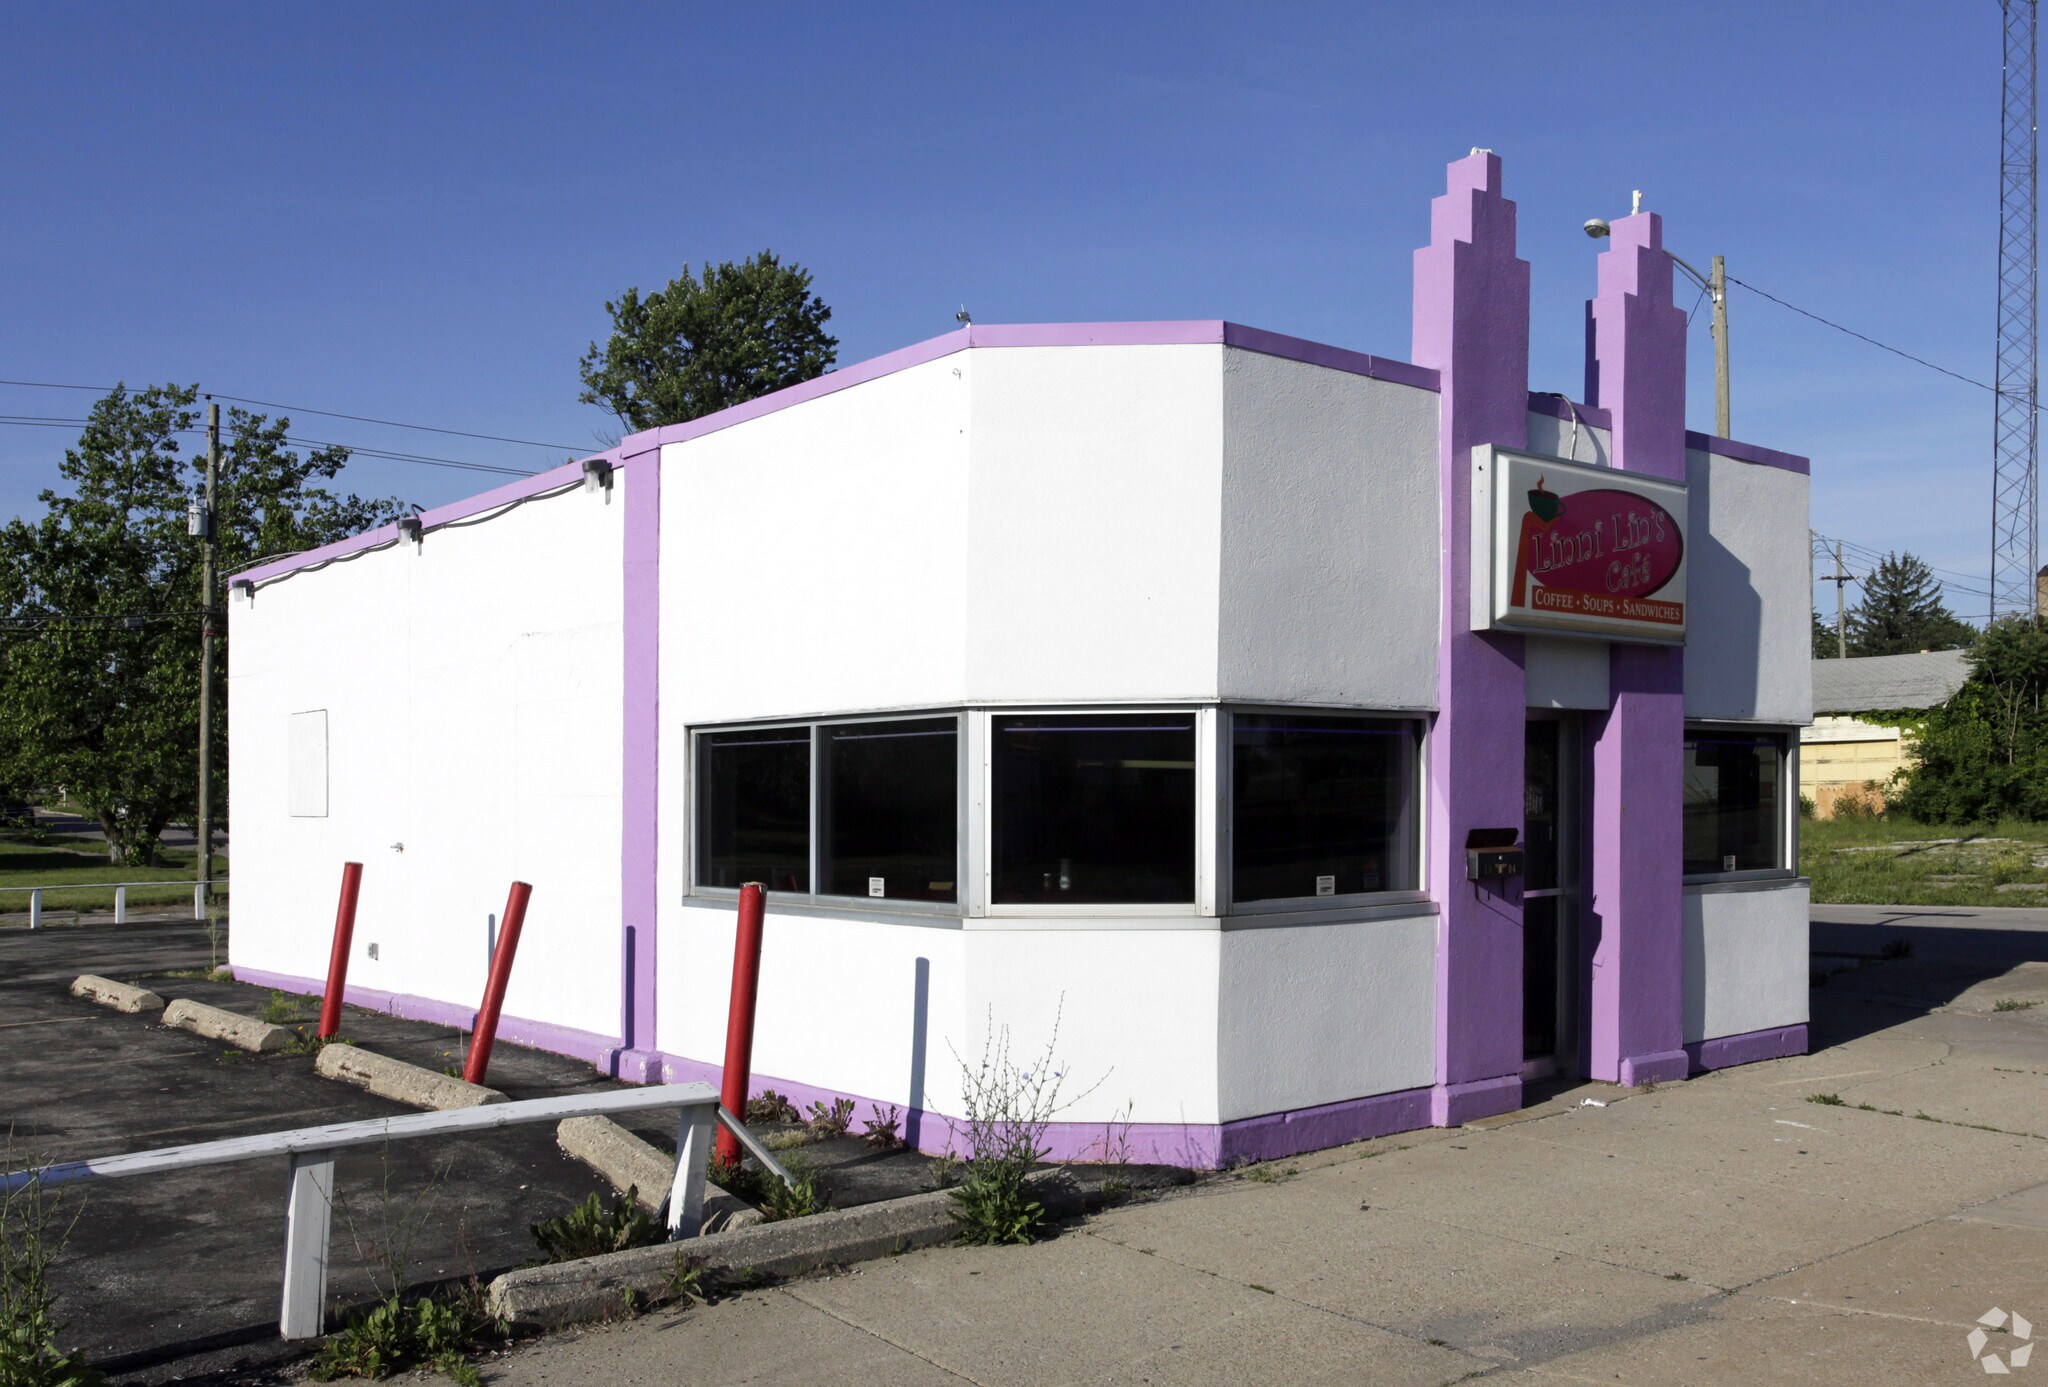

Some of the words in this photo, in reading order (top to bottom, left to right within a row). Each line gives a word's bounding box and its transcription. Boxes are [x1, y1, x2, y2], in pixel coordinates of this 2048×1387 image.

[1532, 519, 1604, 574] Linni
[1611, 508, 1665, 552] Lin's
[1606, 552, 1652, 592] Café
[1535, 589, 1574, 609] COFFEE
[1582, 594, 1614, 613] SOUPS
[1623, 602, 1680, 621] SANDWICHES
